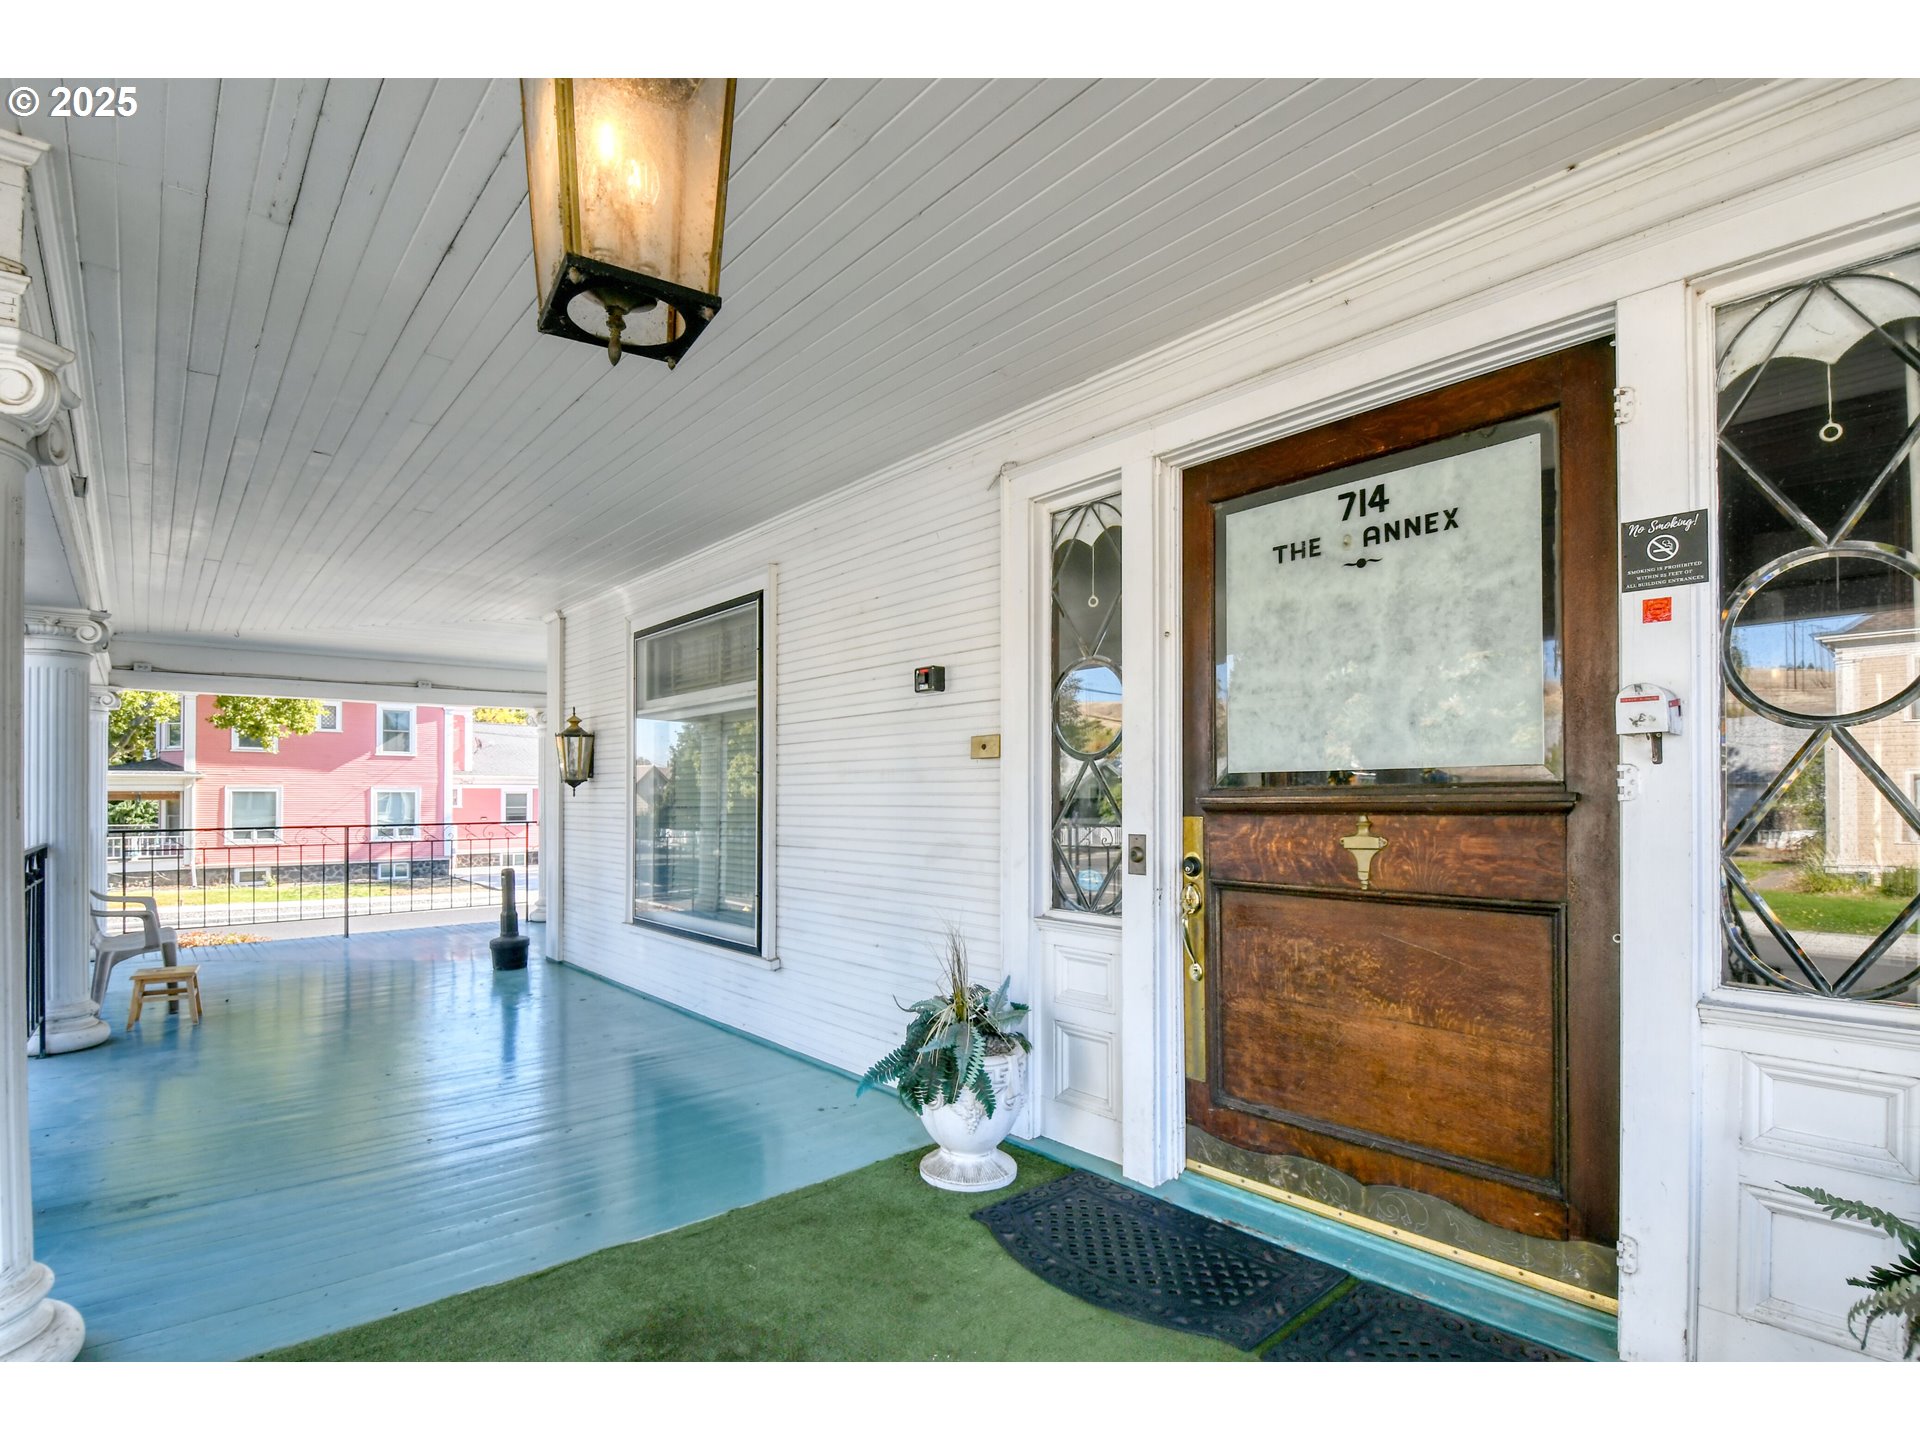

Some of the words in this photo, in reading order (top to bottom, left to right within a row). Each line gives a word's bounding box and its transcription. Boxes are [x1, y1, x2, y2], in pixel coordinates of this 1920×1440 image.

[1337, 483, 1390, 522] 714
[1628, 524, 1645, 538] No
[1647, 513, 1699, 534] Smoking!
[1272, 537, 1322, 564] THE
[1363, 507, 1459, 547] ANNEX
[1627, 567, 1656, 575] SMOKING
[1664, 561, 1703, 570] PROHIBITED
[1636, 573, 1659, 581] WITHIN
[1637, 580, 1667, 588] BUILDING
[1667, 575, 1705, 584] ENTRANCES
